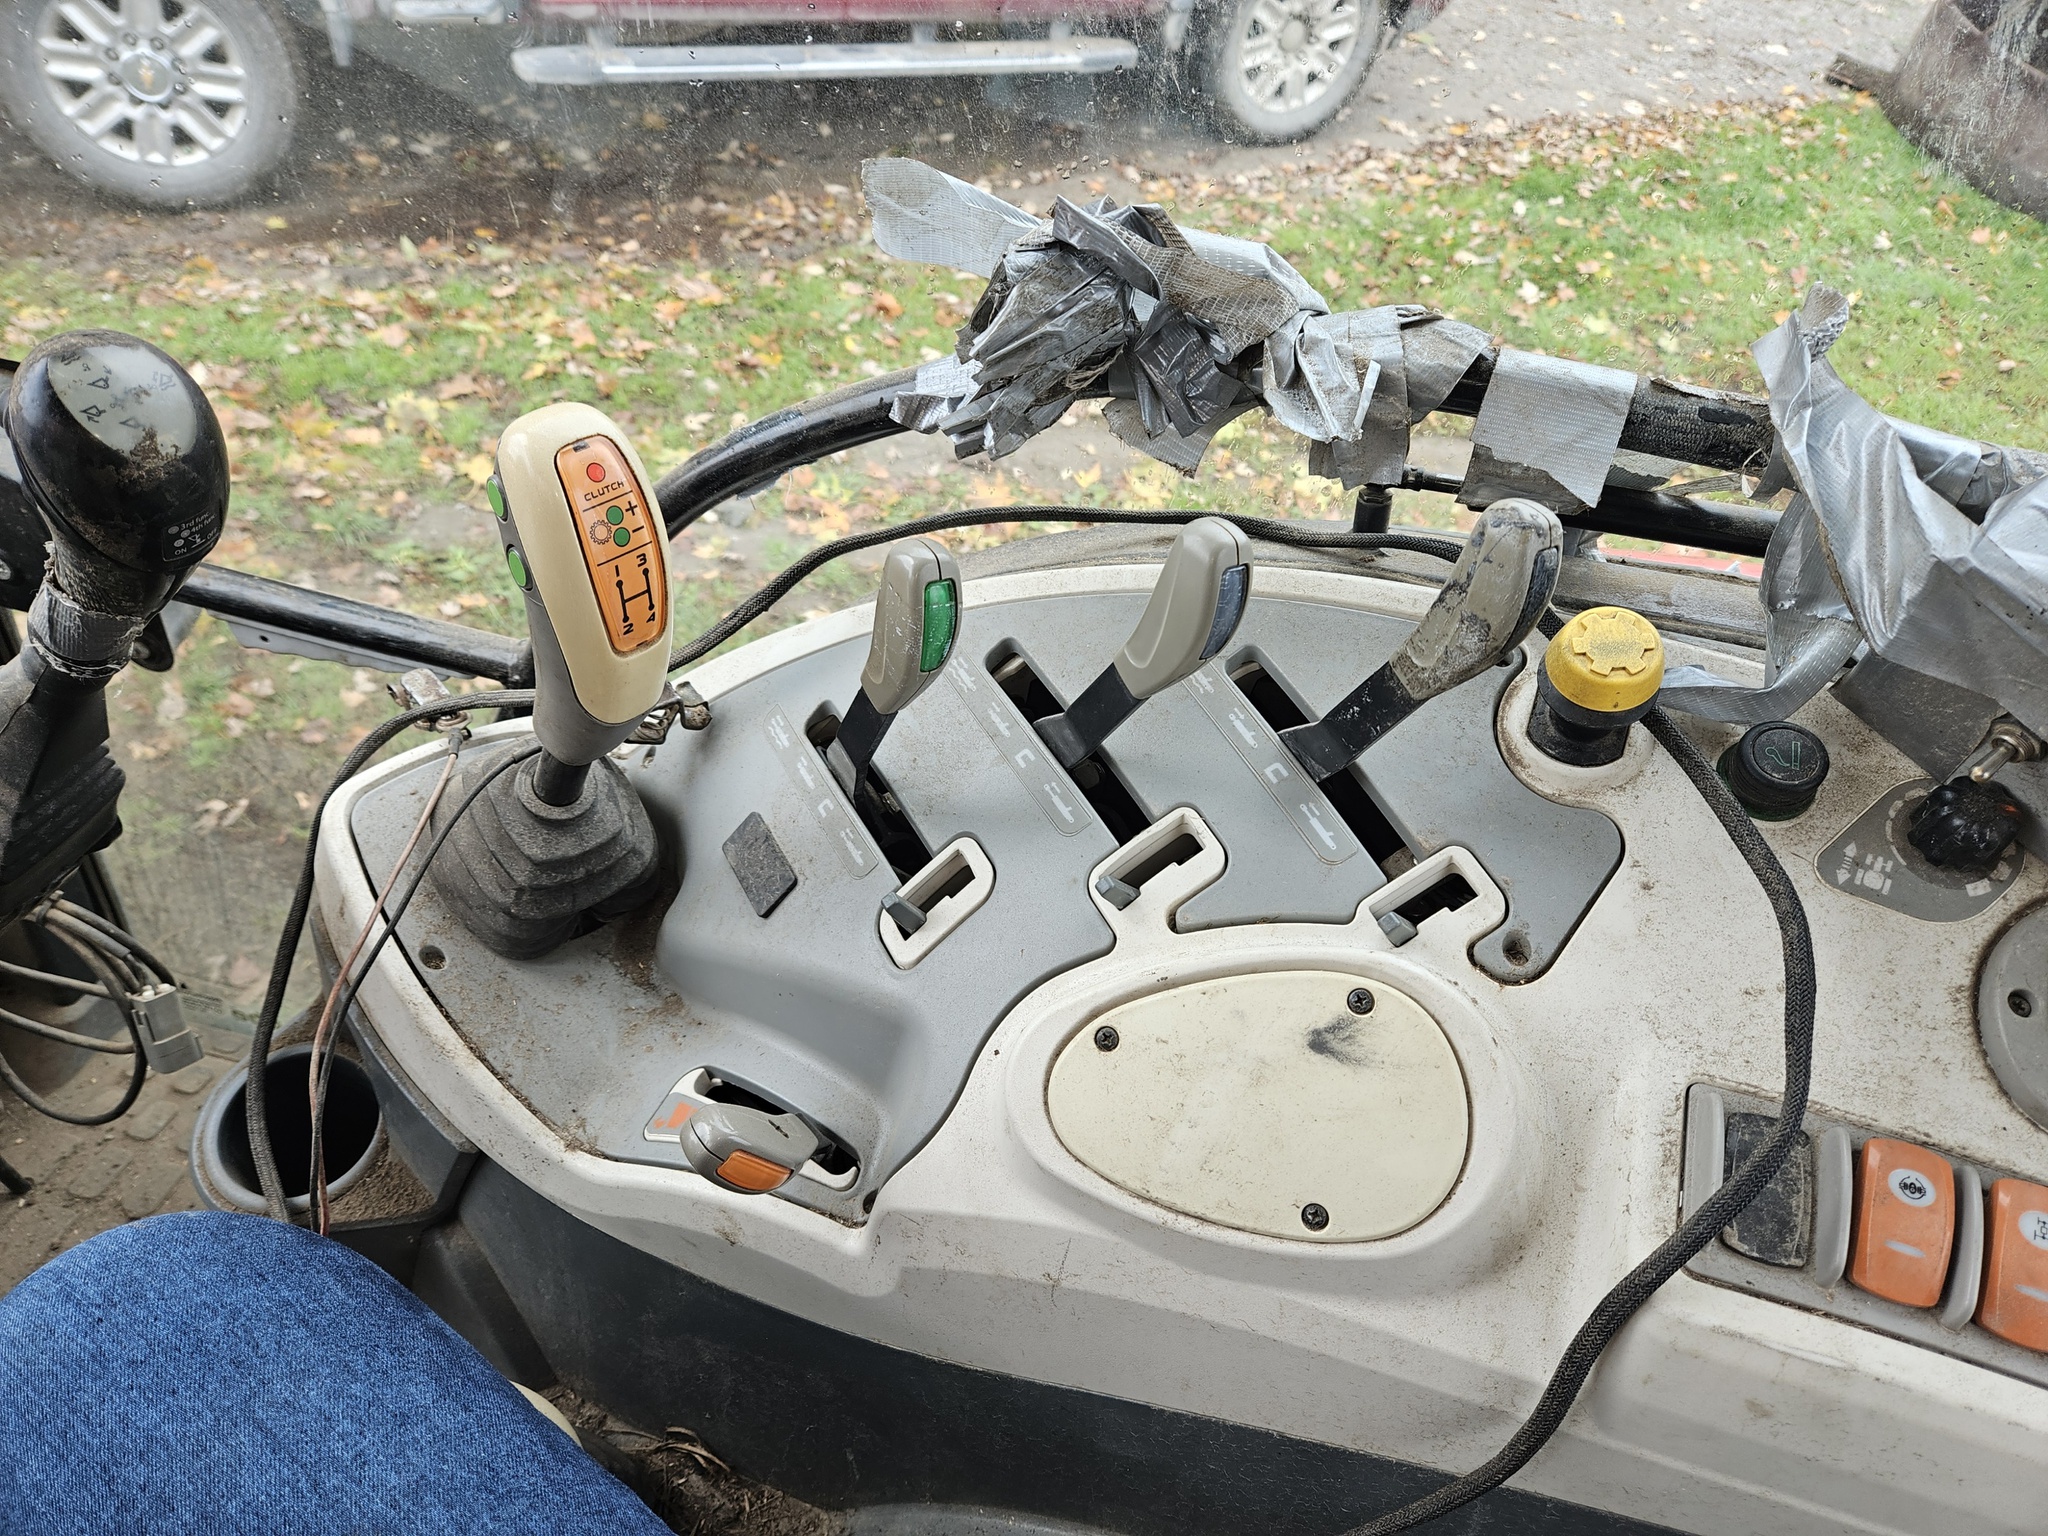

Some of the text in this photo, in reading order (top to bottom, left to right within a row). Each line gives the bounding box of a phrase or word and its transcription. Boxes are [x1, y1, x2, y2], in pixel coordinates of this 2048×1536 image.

[584, 480, 625, 502] CLUTCH
[180, 519, 194, 530] 3rd
[174, 547, 187, 555] ON
[636, 553, 647, 567] 3
[614, 564, 620, 577] 1
[646, 611, 656, 624] 4
[623, 622, 634, 636] 2
